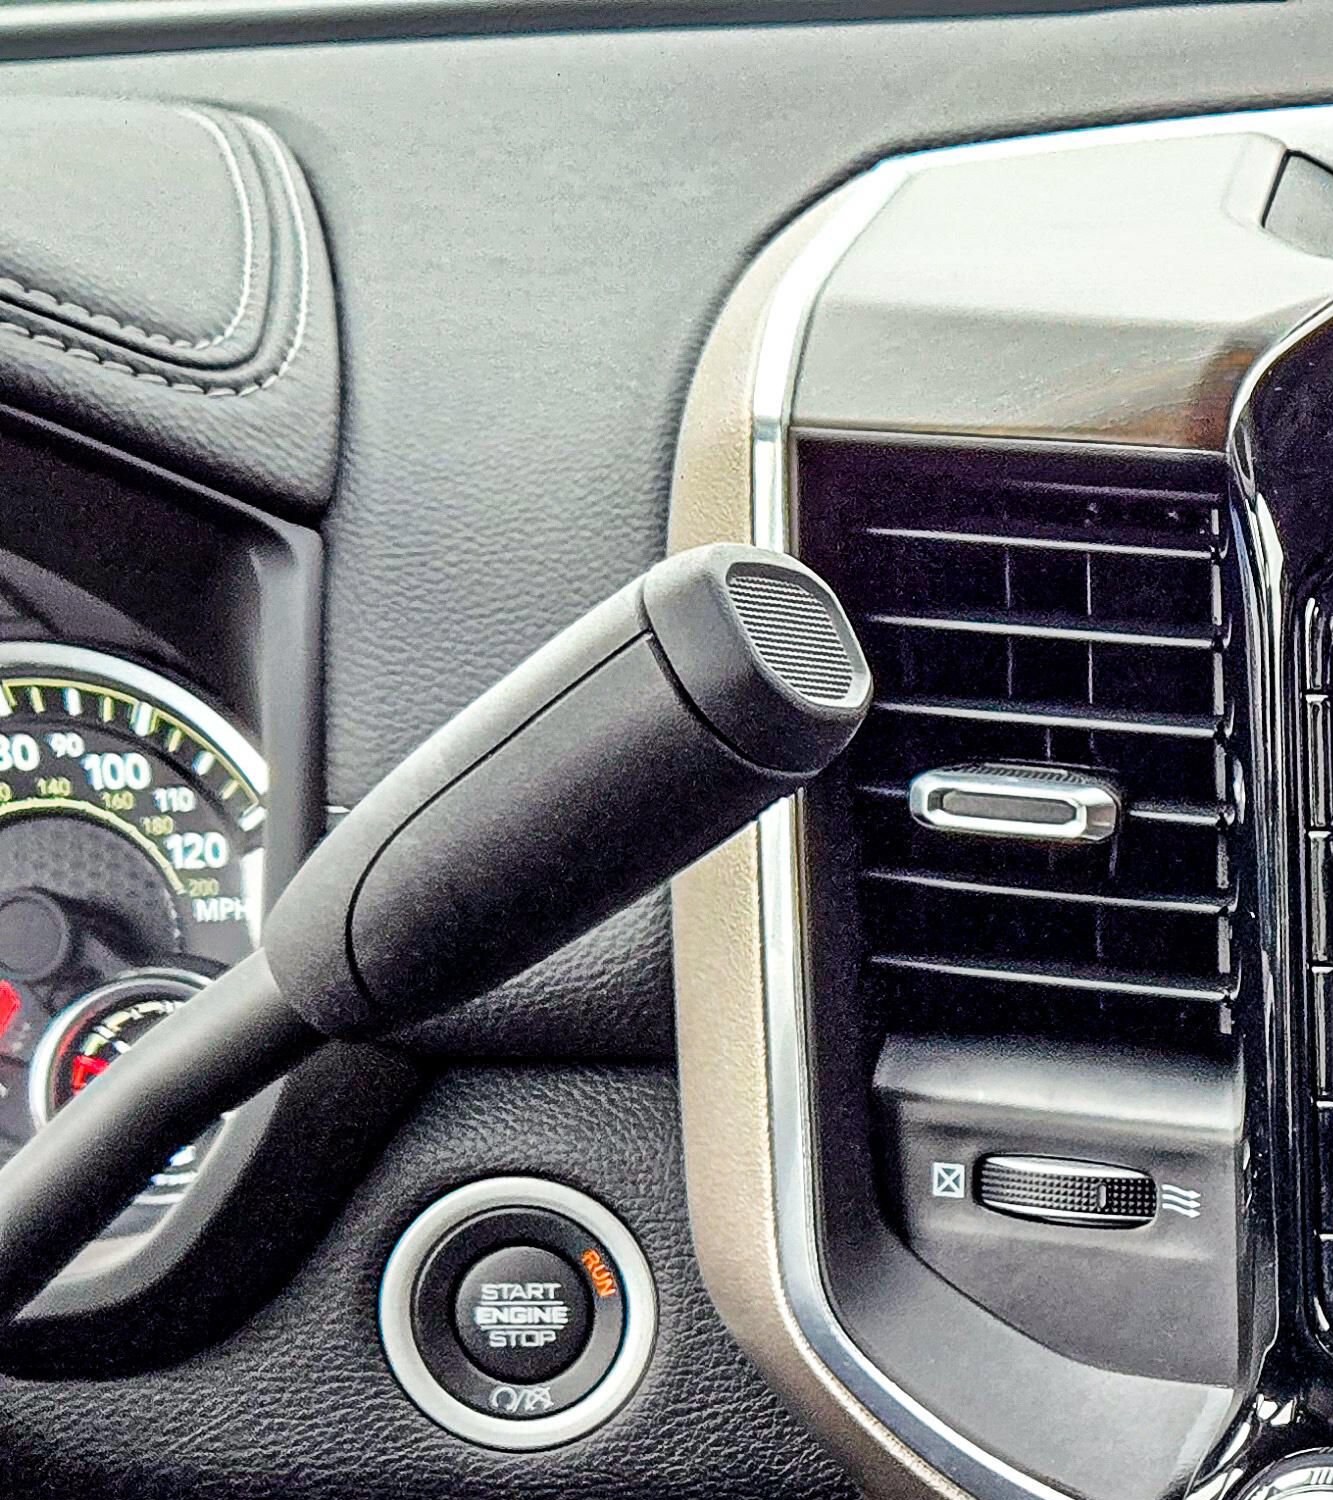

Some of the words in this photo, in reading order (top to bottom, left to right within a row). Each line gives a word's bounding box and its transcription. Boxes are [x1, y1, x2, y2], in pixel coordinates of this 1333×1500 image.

[48, 732, 86, 757] 90
[80, 752, 151, 790] 100
[153, 786, 196, 812] 110
[163, 832, 229, 869] 120
[580, 1248, 617, 1297] RUN
[480, 1282, 562, 1300] START
[475, 1305, 569, 1325] ENGINE
[489, 1330, 556, 1348] STOP
